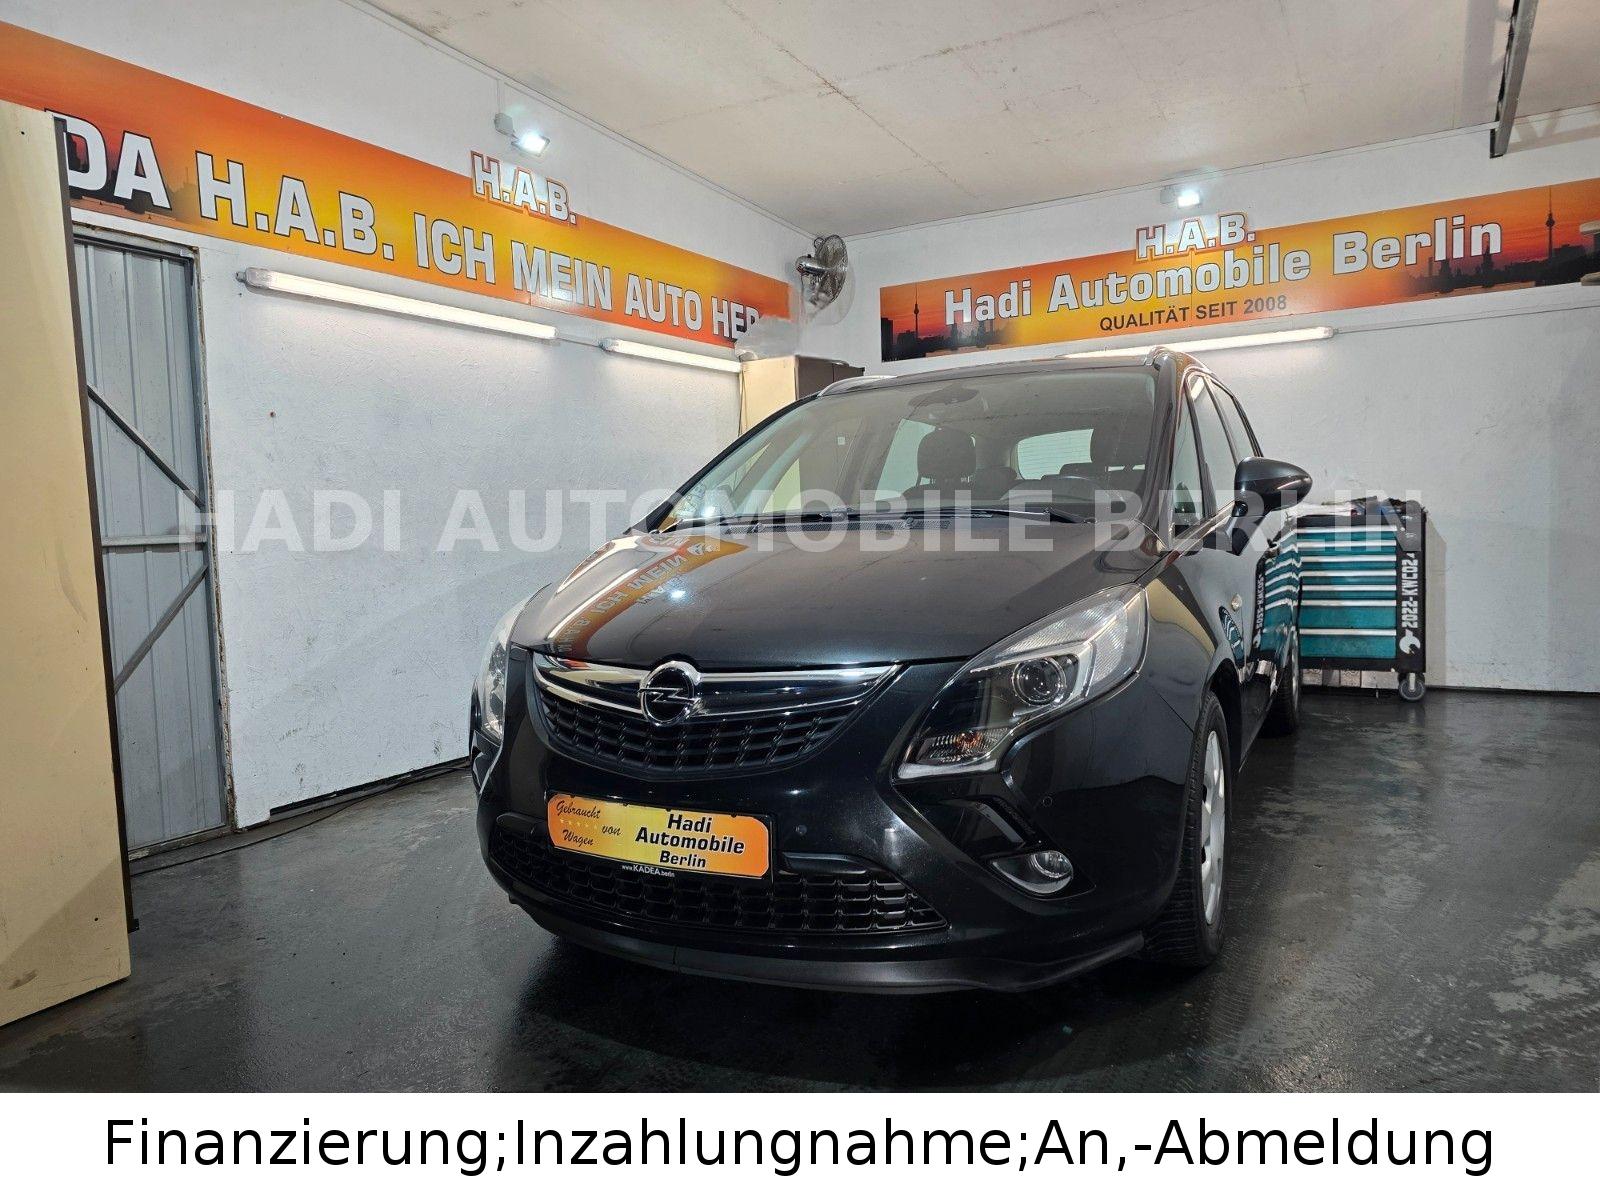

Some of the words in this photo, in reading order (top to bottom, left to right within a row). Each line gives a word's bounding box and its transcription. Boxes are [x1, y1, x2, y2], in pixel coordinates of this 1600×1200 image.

[471, 151, 577, 225] H.A.B.
[195, 151, 394, 261] H.A.B.
[413, 213, 496, 285] ICH
[511, 241, 613, 311] MEIN
[625, 274, 703, 332] AUTO
[1137, 212, 1257, 261] H.A.B.
[944, 280, 1032, 326] Hadi
[1047, 244, 1312, 313] Automobile
[1332, 214, 1502, 276] Berlin
[1099, 305, 1189, 332] QUALITÄT
[1196, 301, 1236, 319] SEIT
[1243, 295, 1288, 315] 2008
[556, 800, 601, 819] Gebraucht
[667, 813, 712, 833] Hadi
[562, 829, 594, 847] Wagen
[601, 825, 621, 836] von
[635, 827, 745, 854] Automobile
[659, 850, 706, 868] Berlin
